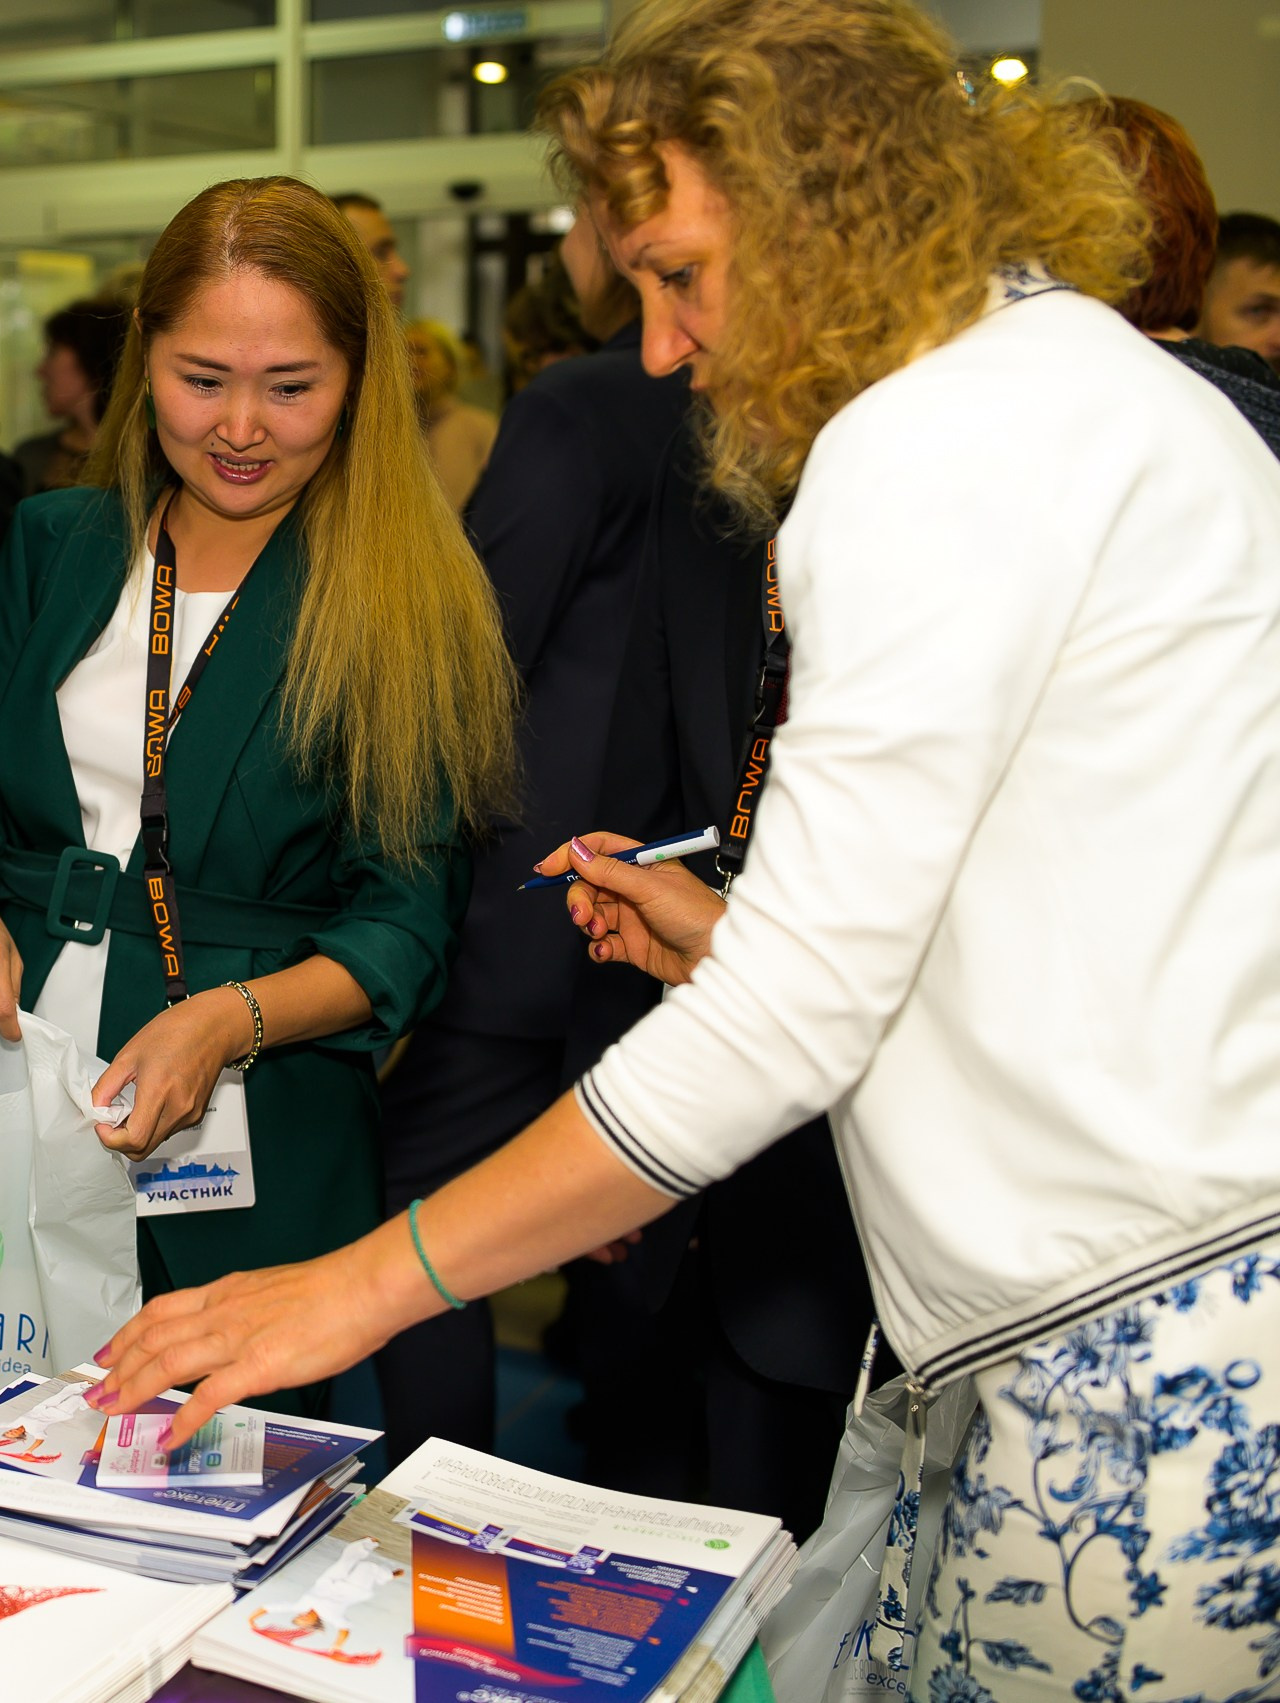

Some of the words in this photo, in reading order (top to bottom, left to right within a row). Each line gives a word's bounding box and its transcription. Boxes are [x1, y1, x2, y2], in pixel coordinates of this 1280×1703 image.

[151, 565, 174, 655] BOWA
[147, 877, 179, 976] BOWA
[145, 1183, 234, 1205] УЧАСТНИК
